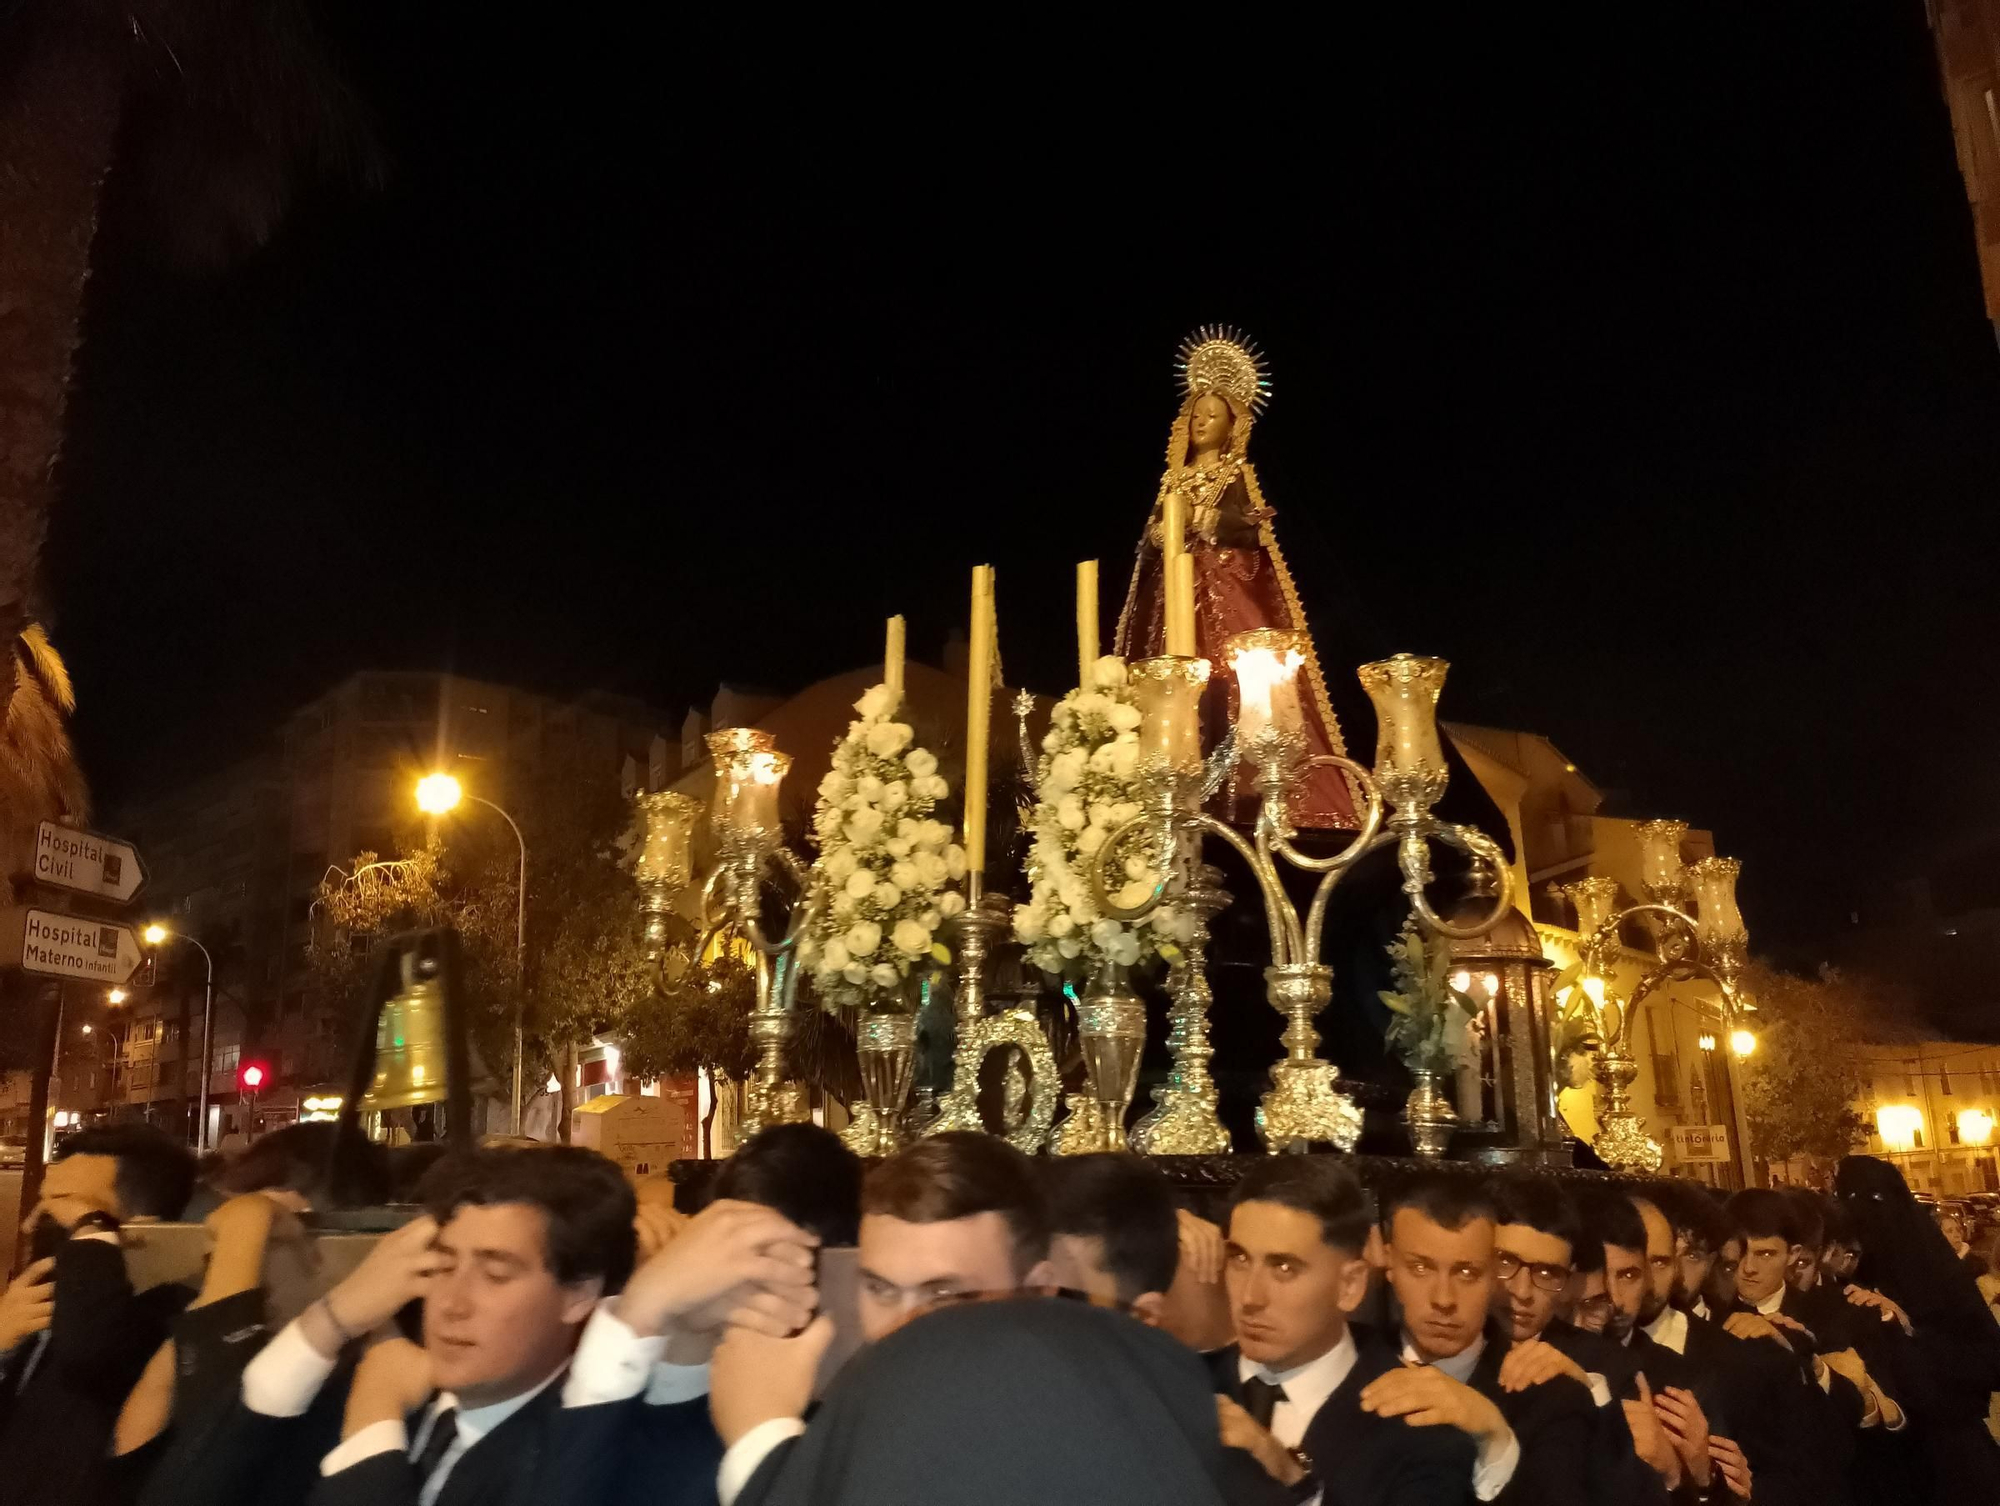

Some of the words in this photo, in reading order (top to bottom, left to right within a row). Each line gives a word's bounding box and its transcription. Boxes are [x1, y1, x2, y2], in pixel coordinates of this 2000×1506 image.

[41, 829, 103, 863] Hospital
[39, 854, 73, 879] Civil
[28, 919, 97, 948] Hospital
[26, 944, 83, 969] Materno
